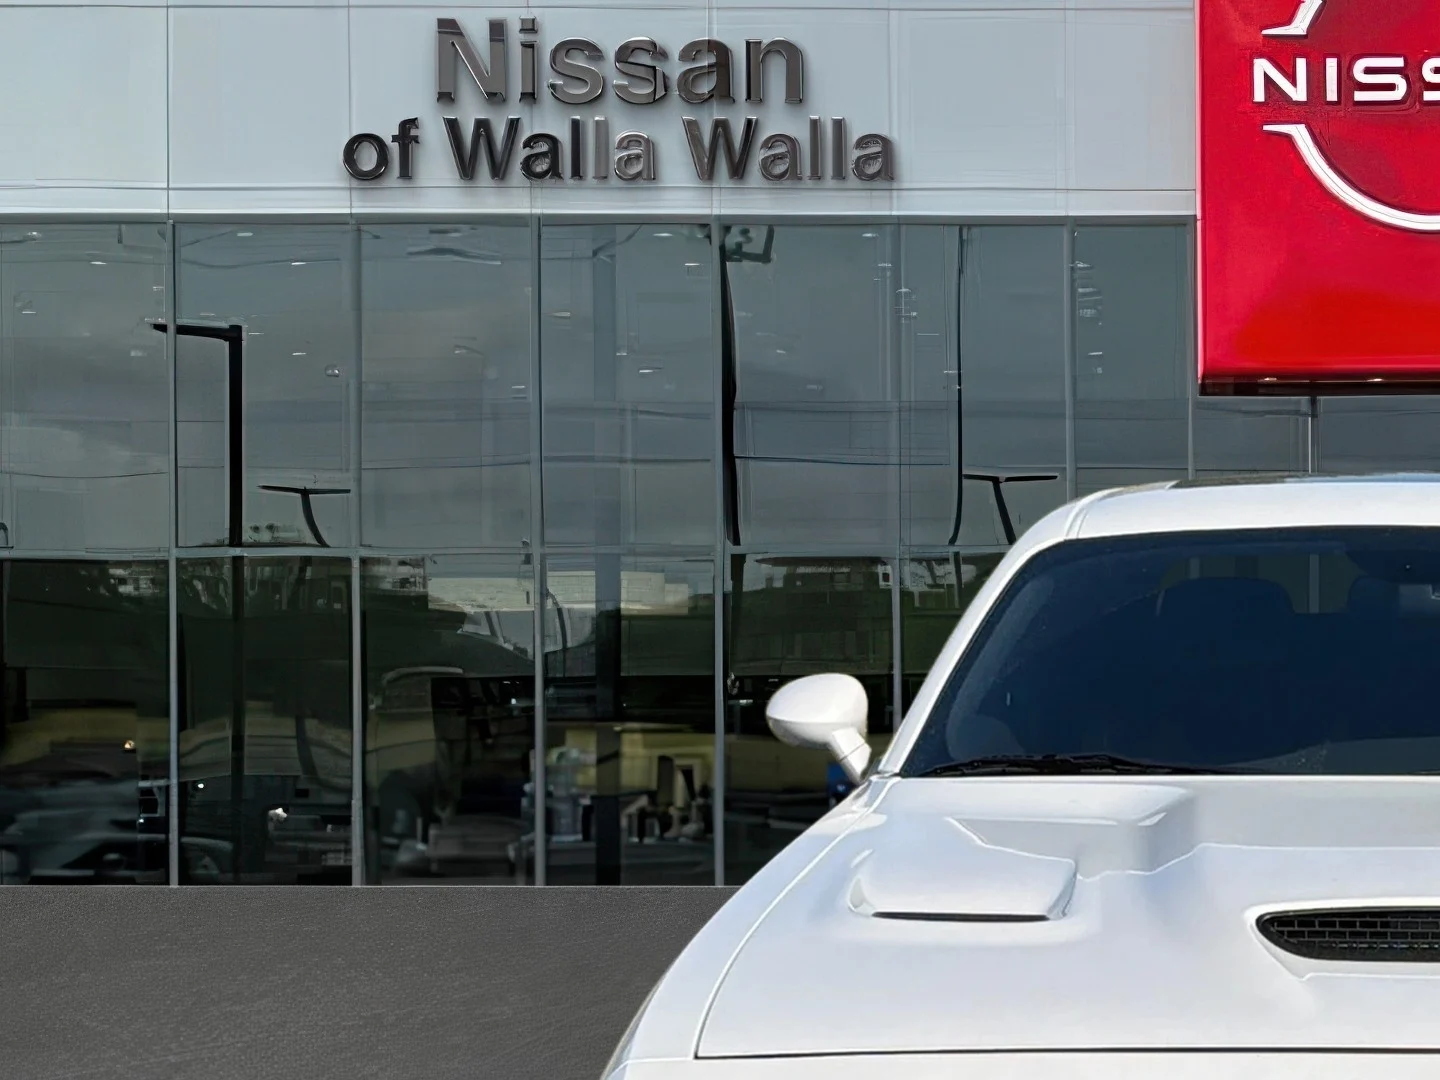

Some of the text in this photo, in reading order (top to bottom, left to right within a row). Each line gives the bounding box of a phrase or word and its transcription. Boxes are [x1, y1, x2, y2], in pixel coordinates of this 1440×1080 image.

[437, 17, 804, 104] Nissan
[342, 116, 895, 181] of Walla Walla
